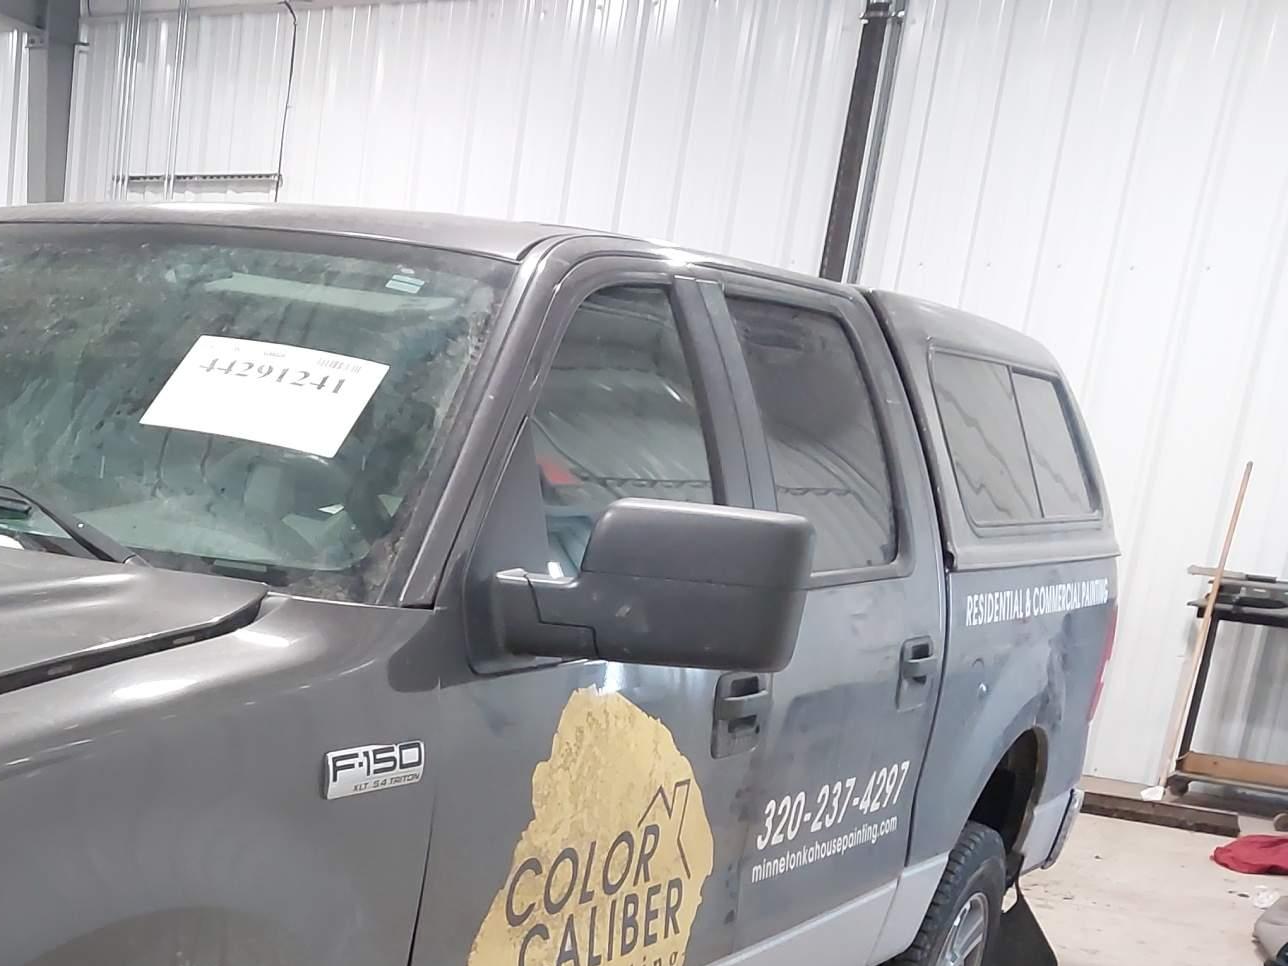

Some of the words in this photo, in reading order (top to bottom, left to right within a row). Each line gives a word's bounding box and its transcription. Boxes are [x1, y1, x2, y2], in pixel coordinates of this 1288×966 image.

[199, 357, 347, 394] 44291241
[966, 588, 1023, 627] RESIDENTIAL
[1025, 588, 1031, 617] &
[1032, 581, 1081, 617] COMMERCIAL
[332, 742, 423, 783] F-150
[352, 782, 369, 793] XLT
[388, 772, 421, 785] TRITON
[756, 760, 911, 850] 320-237-4297
[751, 815, 898, 884] minnetonkahousepainting.com
[505, 823, 662, 928] COLOR
